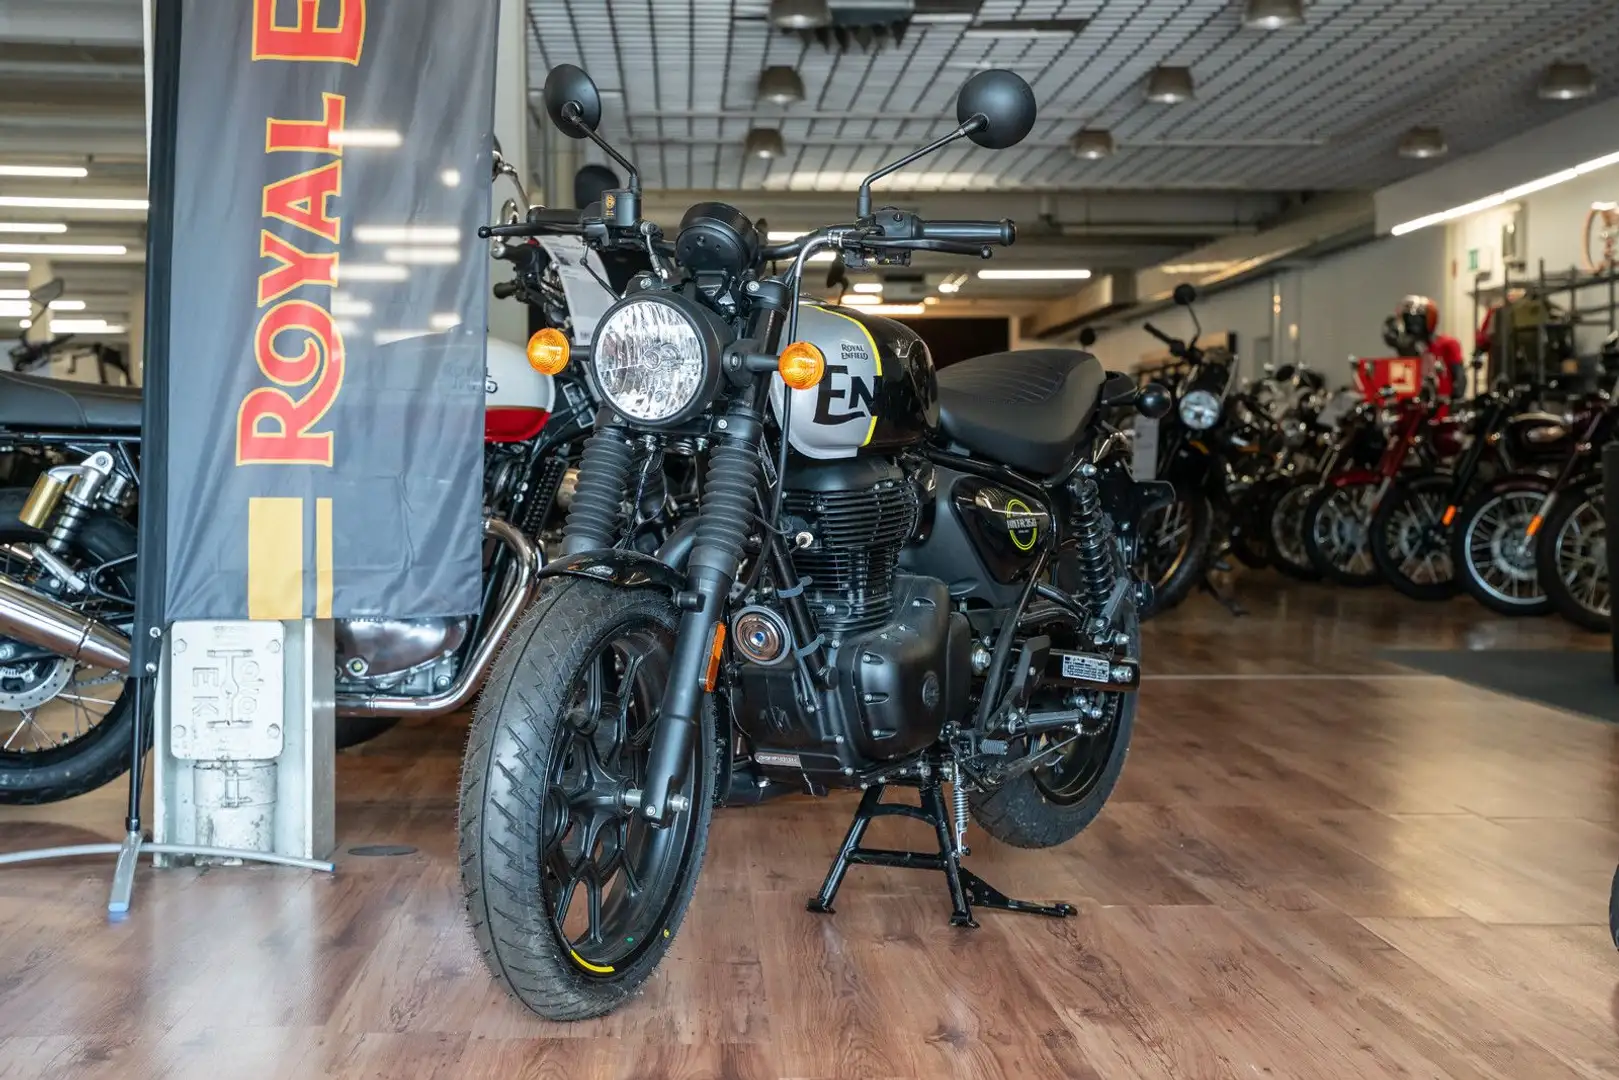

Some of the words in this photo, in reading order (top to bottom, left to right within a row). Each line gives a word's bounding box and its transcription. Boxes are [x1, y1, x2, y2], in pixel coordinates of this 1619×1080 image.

[236, 92, 346, 467] ROYAL
[841, 343, 865, 352] ROYAL
[841, 352, 869, 361] ENFIELD
